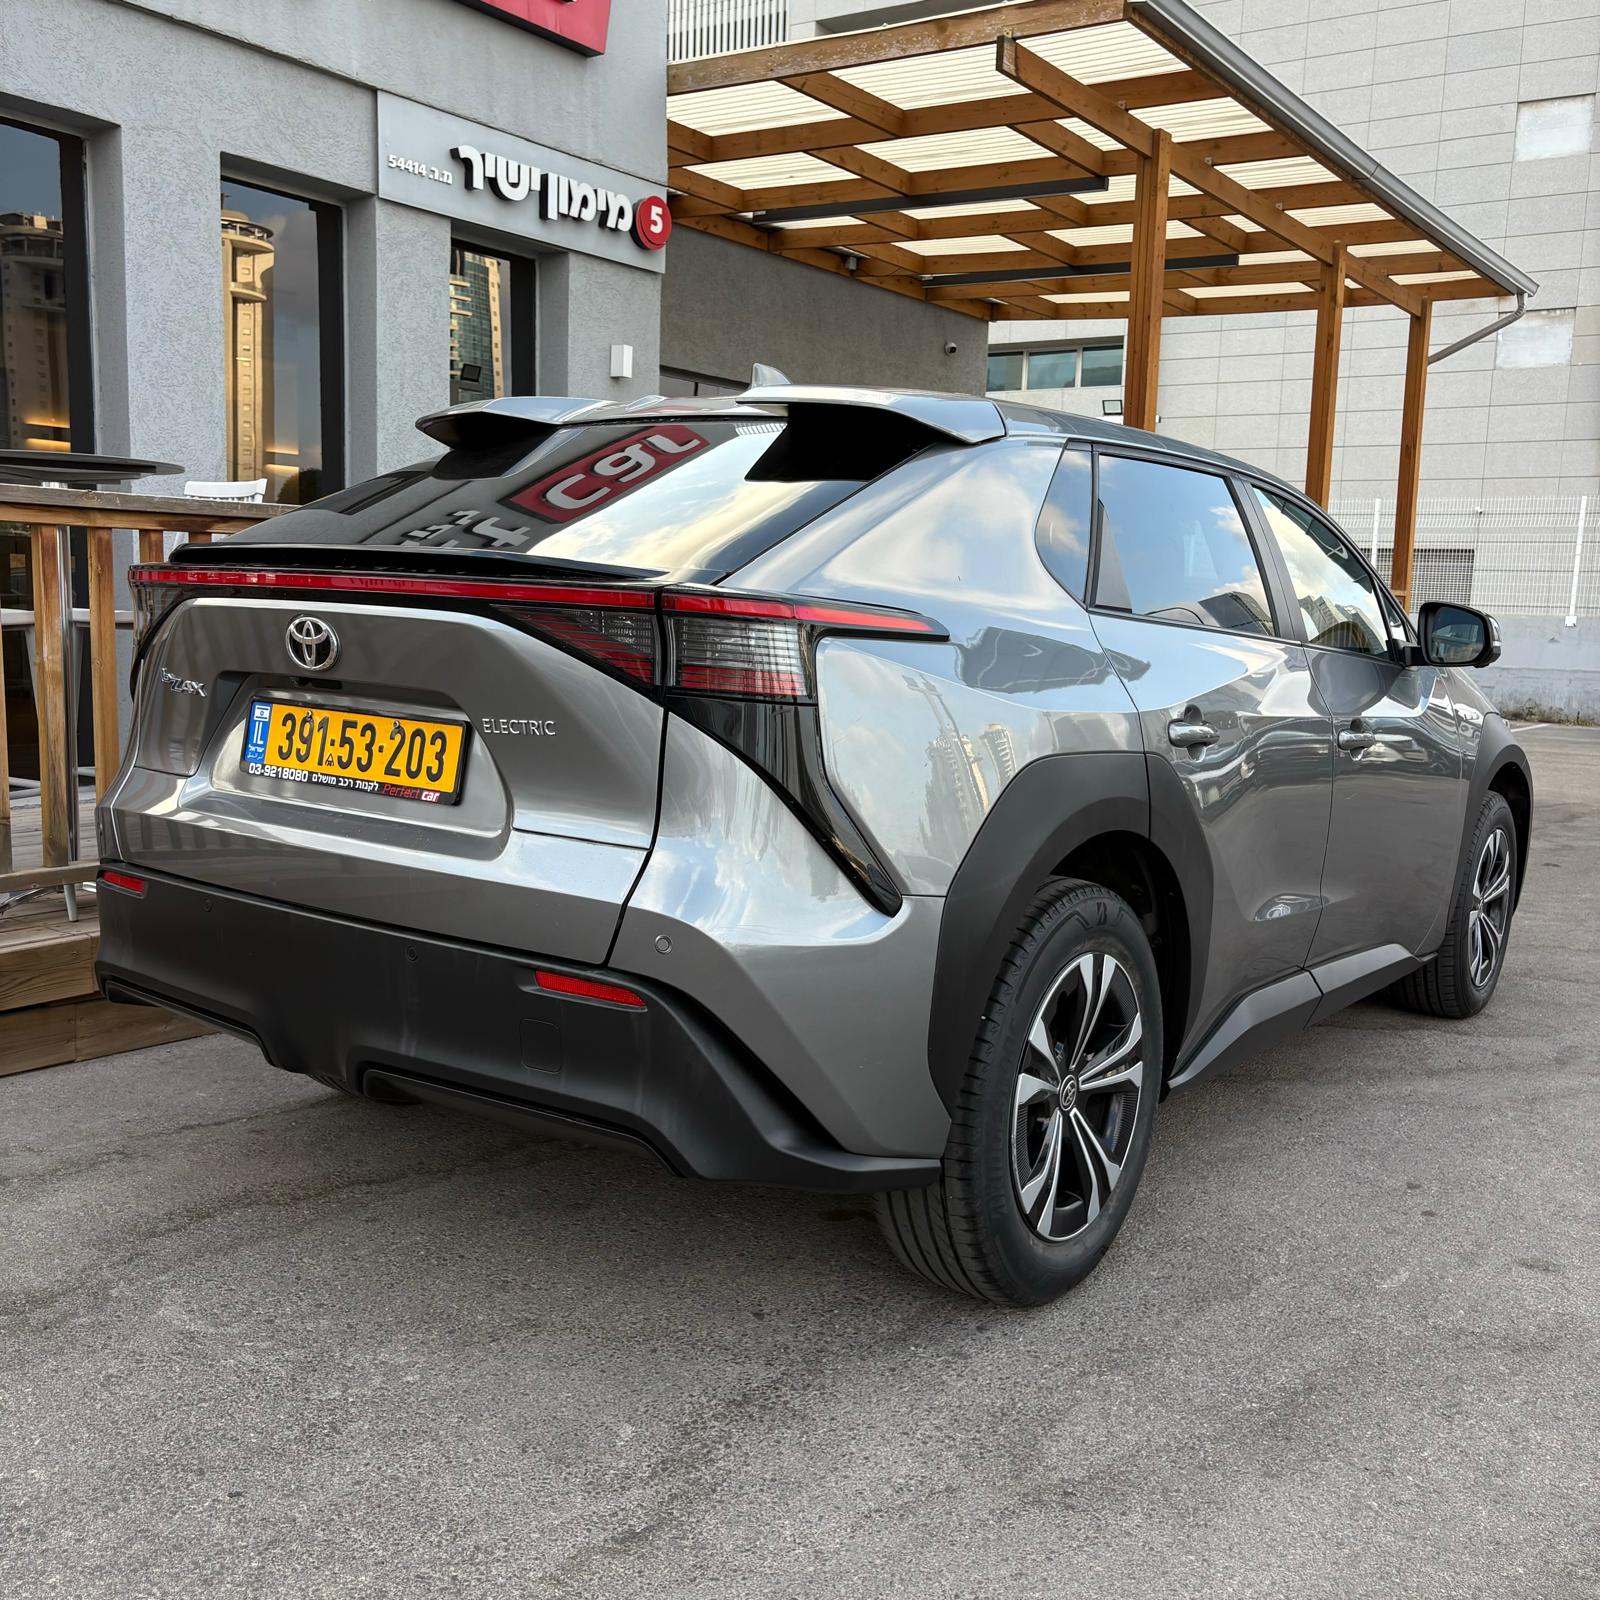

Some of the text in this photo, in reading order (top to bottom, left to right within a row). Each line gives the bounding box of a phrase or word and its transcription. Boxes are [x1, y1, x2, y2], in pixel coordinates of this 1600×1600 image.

[388, 154, 428, 177] 54414
[454, 145, 664, 235] 5 מימון ישיר
[253, 721, 264, 744] IL
[481, 718, 556, 736] ELECTRIC
[248, 762, 309, 782] 03-9218080
[311, 772, 379, 792] לקנות רכב מושלם
[382, 783, 441, 802] Perfect car
